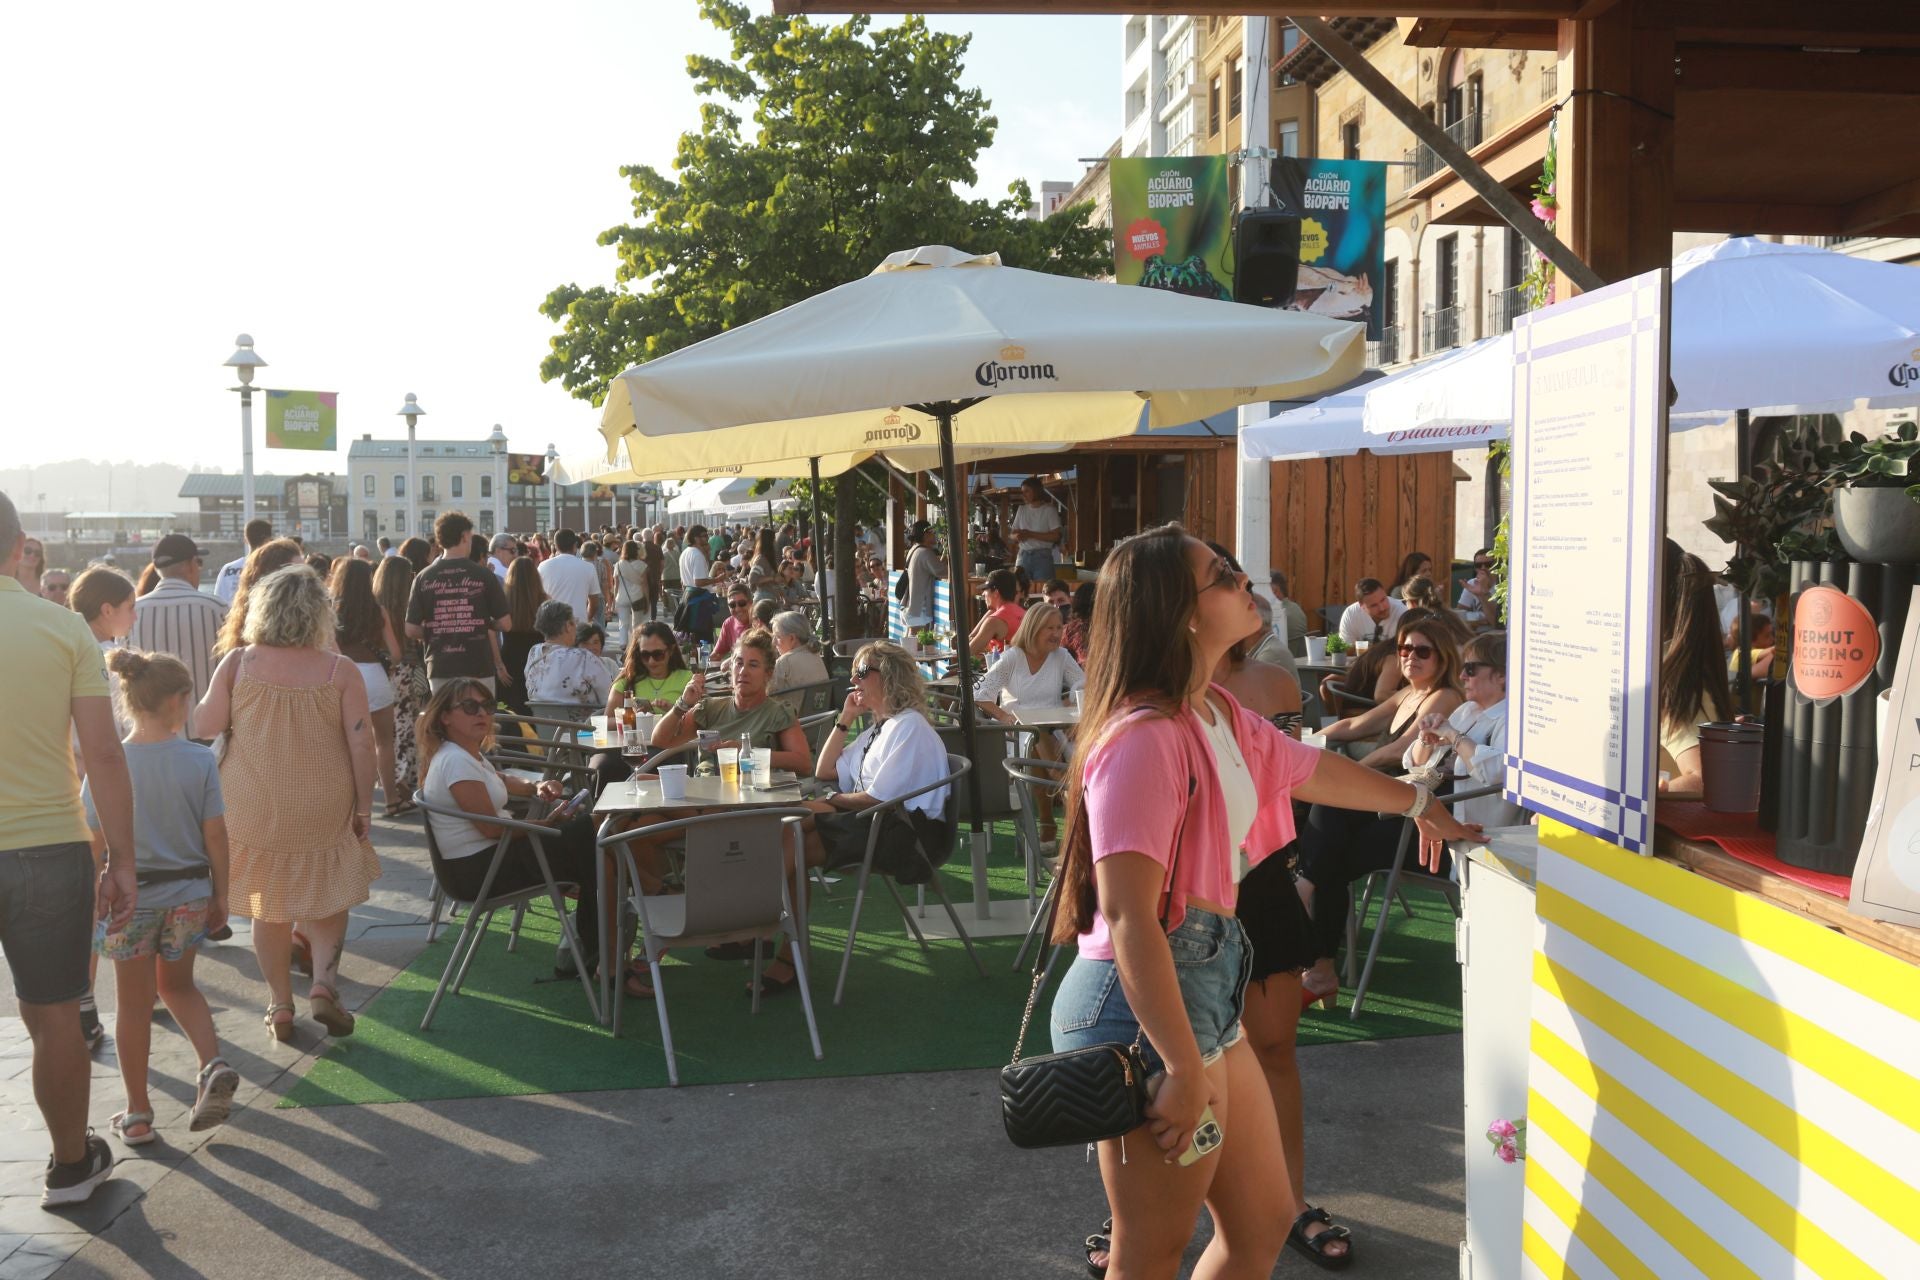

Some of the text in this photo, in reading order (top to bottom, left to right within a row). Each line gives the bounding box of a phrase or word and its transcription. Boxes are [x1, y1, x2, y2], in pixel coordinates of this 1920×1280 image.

[1160, 169, 1180, 177] GIJÓN
[1148, 177, 1193, 190] ACUARIO
[1305, 179, 1350, 193] ACUARIO
[1132, 233, 1158, 243] NUEVOS
[975, 360, 1056, 388] Corona
[284, 409, 319, 419] ACUARIO
[1797, 630, 1855, 645] VERMUT
[1801, 668, 1843, 680] NARANJA
